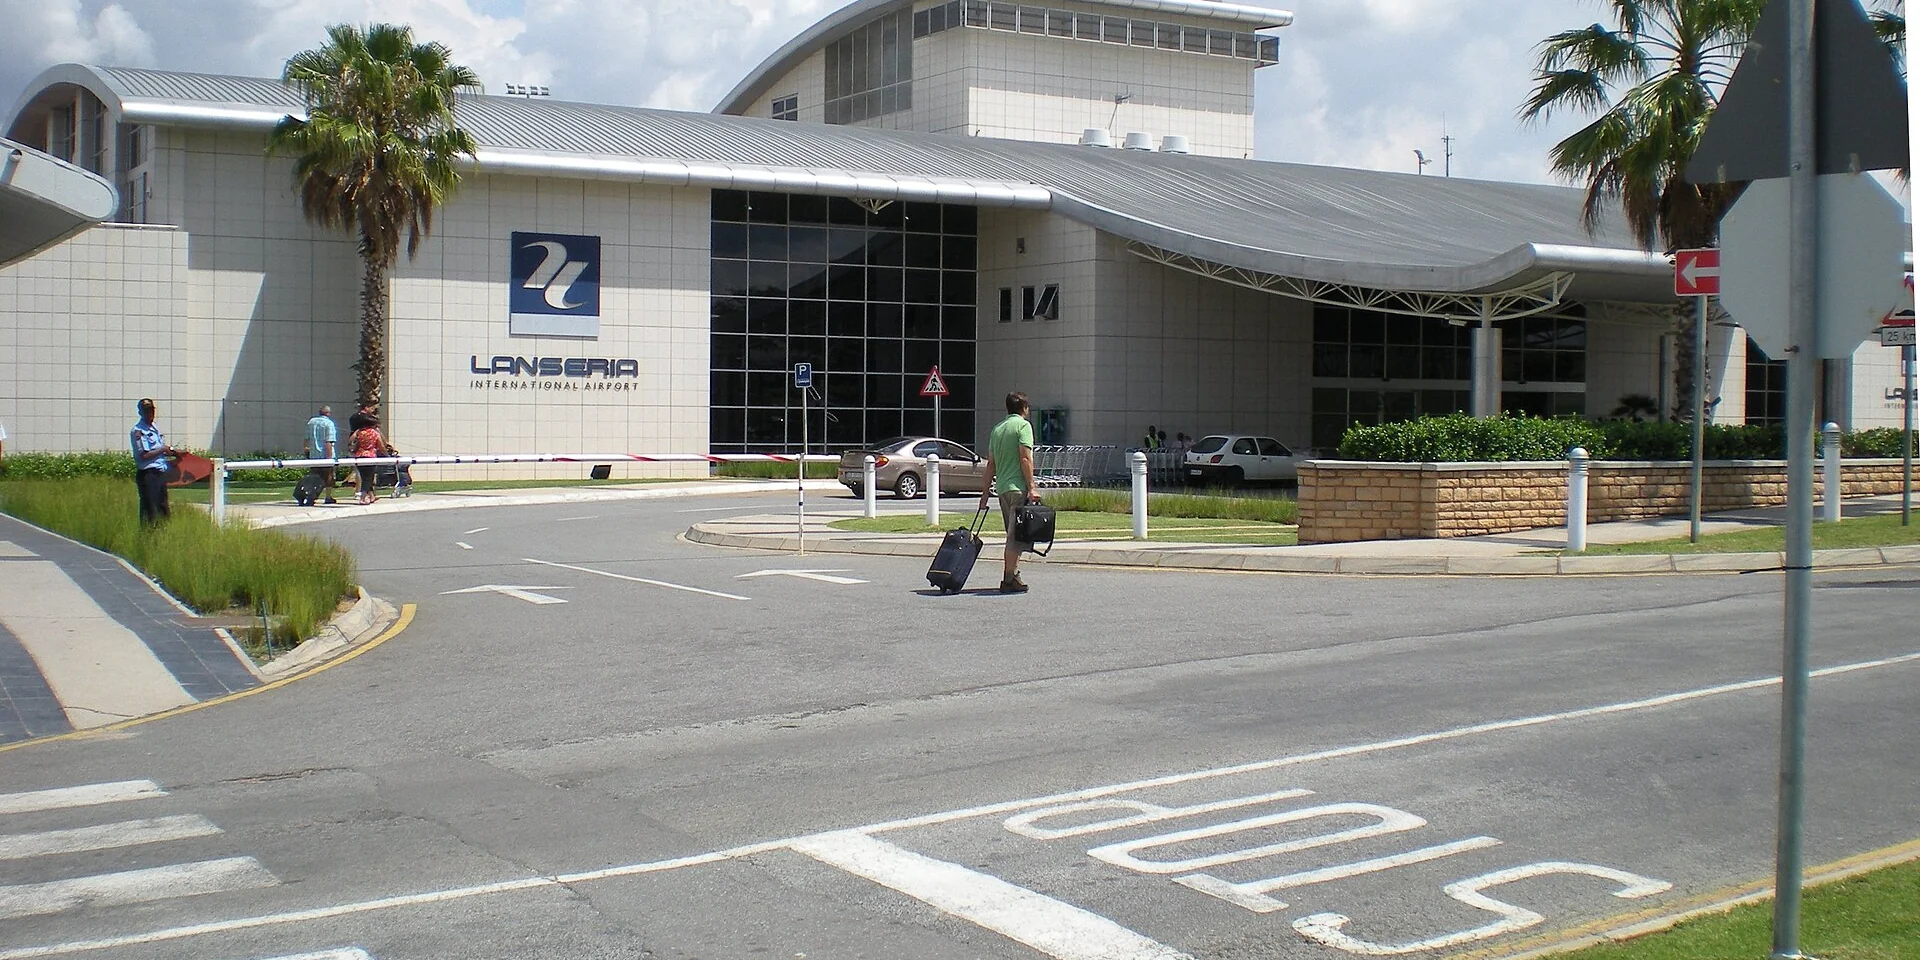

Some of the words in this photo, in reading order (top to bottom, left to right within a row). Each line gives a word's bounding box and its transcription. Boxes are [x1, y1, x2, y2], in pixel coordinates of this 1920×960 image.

[1887, 331, 1899, 341] 25
[471, 355, 639, 379] LANSERIA
[799, 365, 807, 375] P
[470, 380, 578, 391] INTERNATIONAL
[584, 382, 639, 392] AIRPORT
[1003, 788, 1673, 955] STOP
